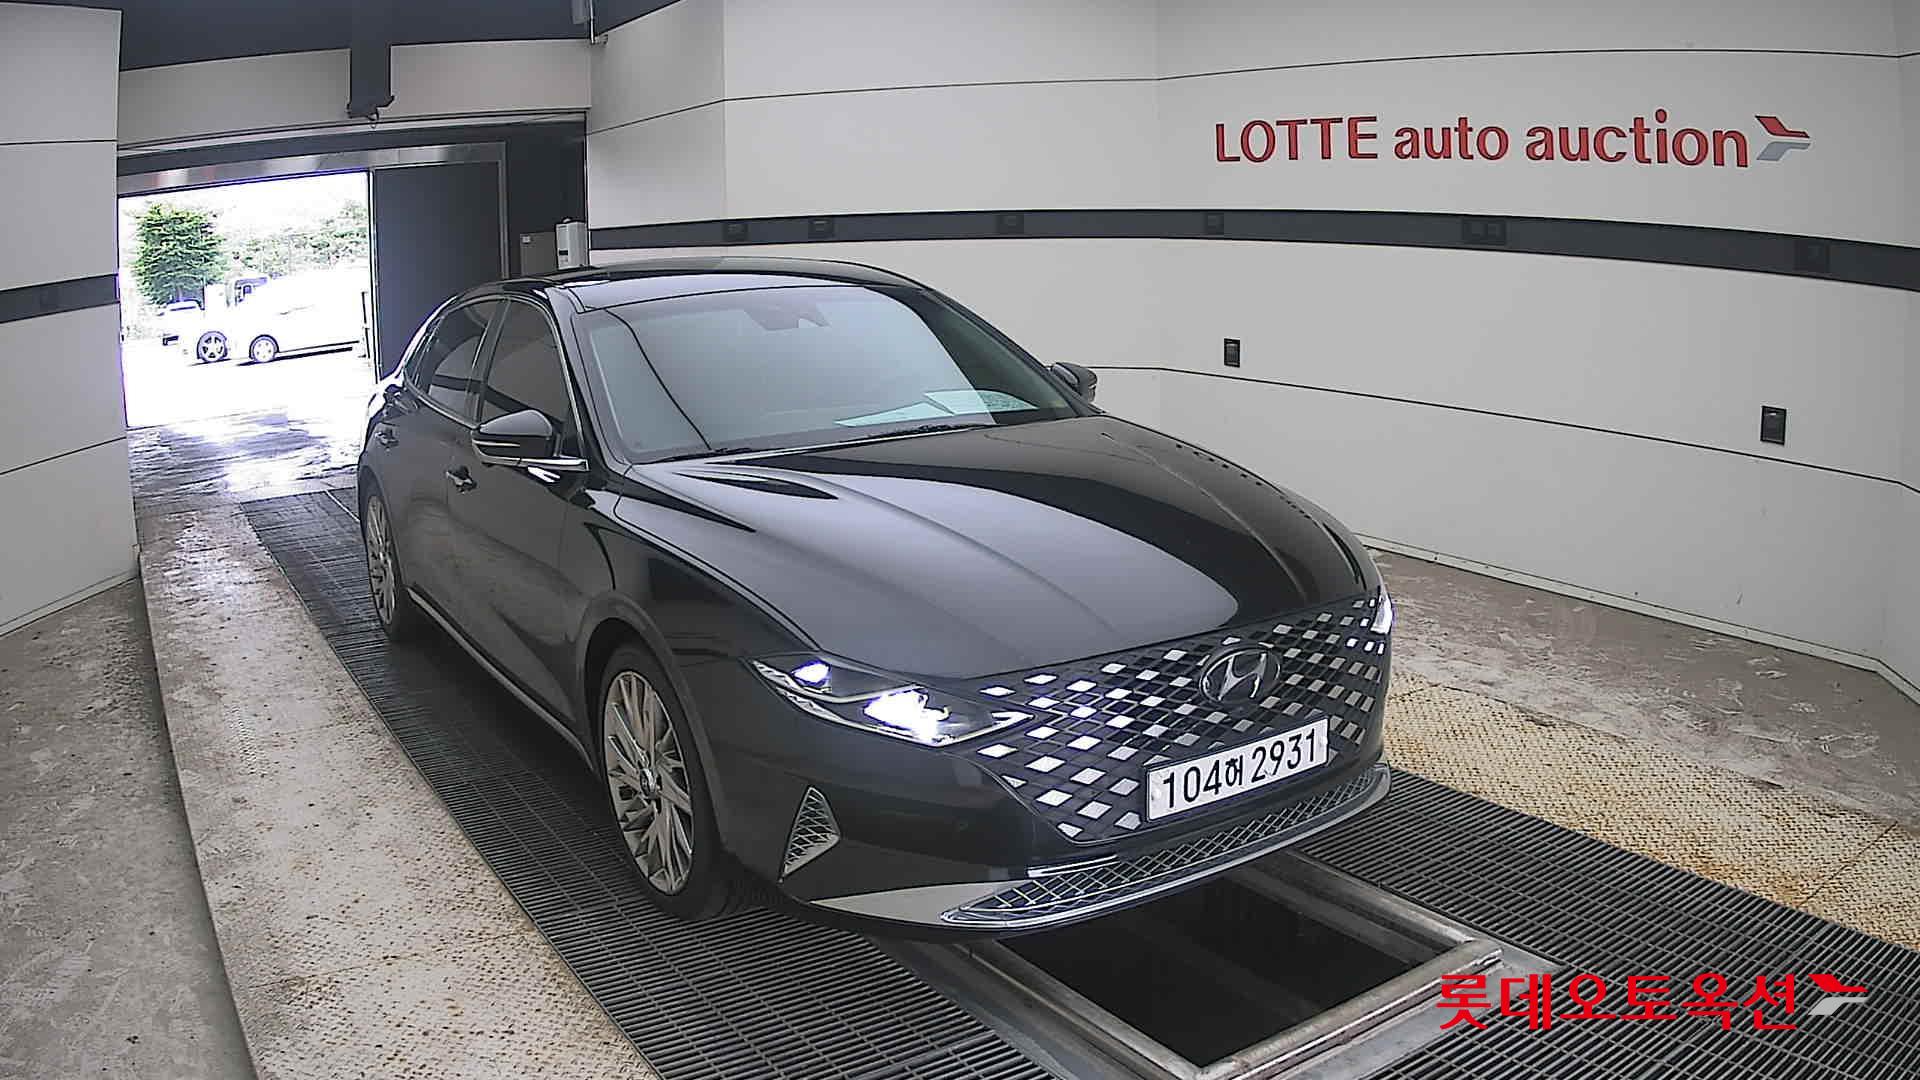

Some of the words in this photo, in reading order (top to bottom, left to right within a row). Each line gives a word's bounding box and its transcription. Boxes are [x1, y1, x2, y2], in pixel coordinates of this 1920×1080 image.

[1216, 116, 1378, 162] LOTTE
[1394, 117, 1510, 161] auto
[1526, 109, 1749, 168] auction
[1163, 755, 1243, 808] 104허
[1251, 728, 1315, 783] 2931
